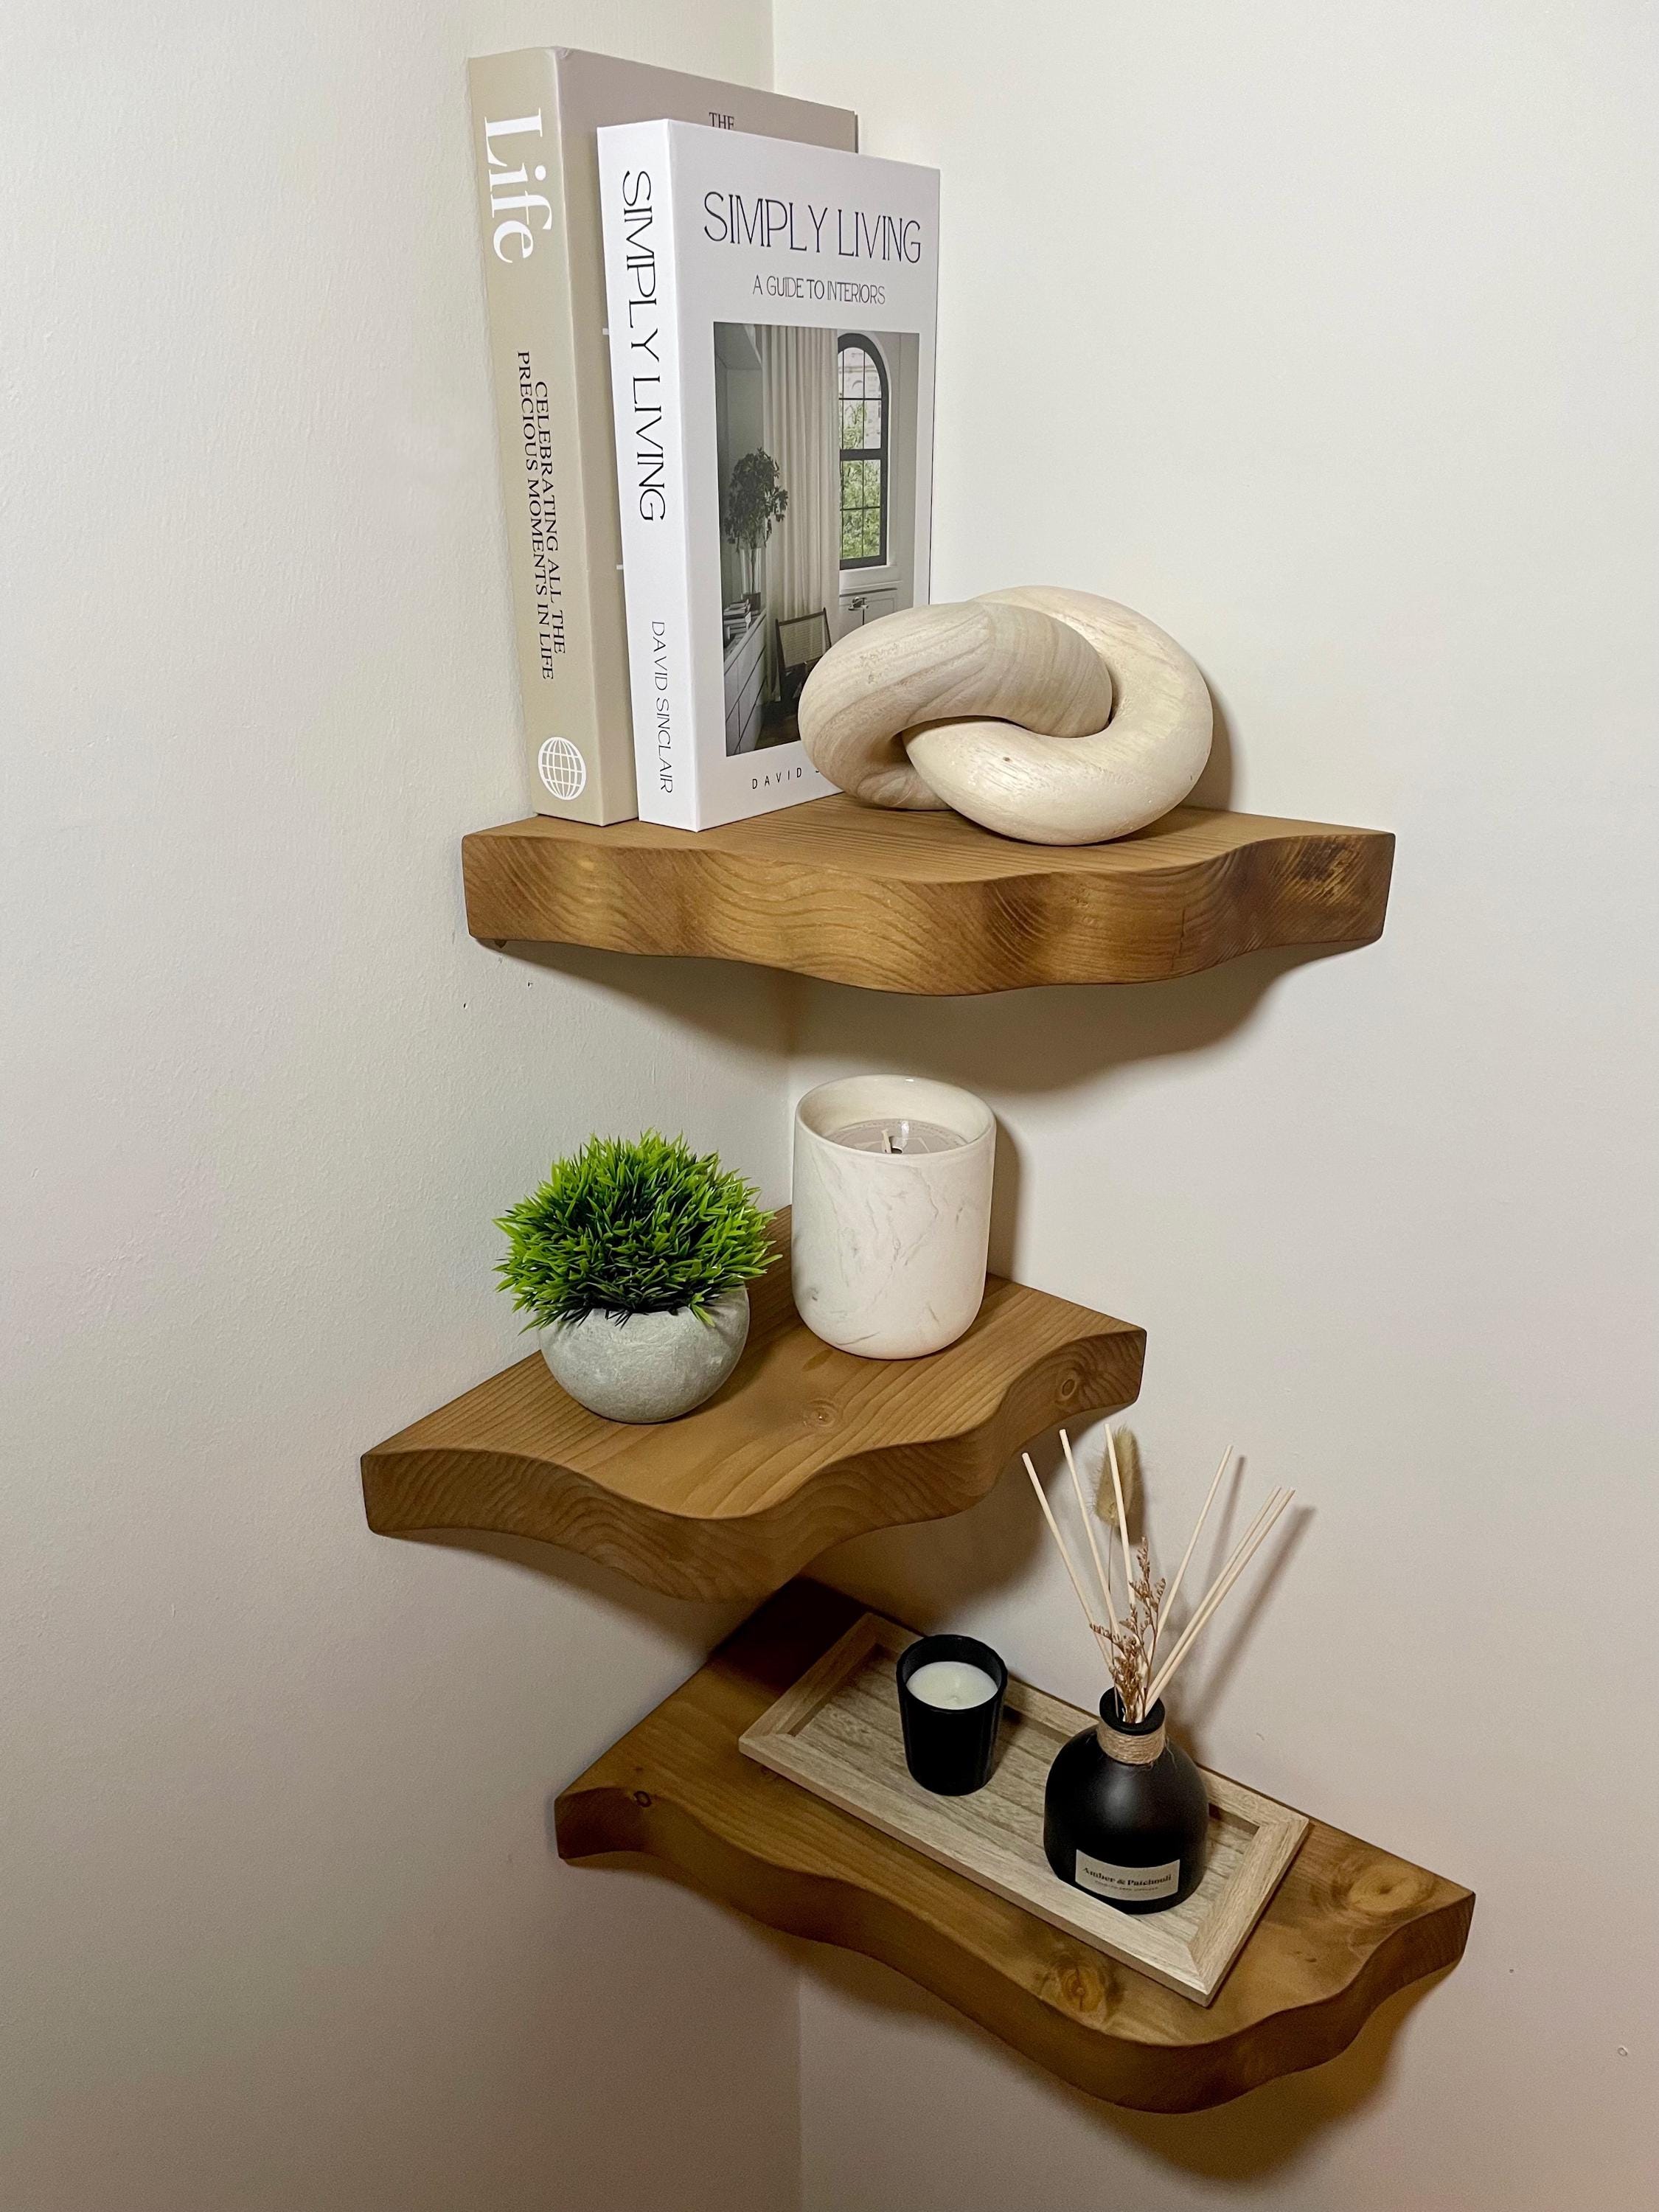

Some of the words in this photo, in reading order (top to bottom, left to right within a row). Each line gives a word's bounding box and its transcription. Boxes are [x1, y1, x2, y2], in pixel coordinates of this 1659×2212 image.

[709, 111, 735, 130] THE
[484, 107, 552, 264] Life
[703, 191, 828, 253] SIMPLY
[838, 209, 921, 263] LIVING
[622, 170, 660, 363] SIMPLY
[752, 274, 763, 295] A
[766, 276, 804, 299] GUIDE
[807, 279, 825, 300] TO
[827, 281, 886, 305] INTERIORS
[518, 351, 538, 471] PRECIOUS
[535, 380, 558, 552] CELEBRATING
[633, 375, 667, 522] LIVING
[527, 479, 547, 596] MOMENTS
[538, 603, 550, 626] IN
[548, 558, 562, 603] ALL
[539, 631, 554, 680] LIFE
[552, 610, 566, 654] THE
[651, 621, 668, 691] DAVID
[655, 697, 673, 793] SINCLAIR
[751, 767, 803, 790] DAVID
[1082, 1867, 1116, 1882] Amber
[1127, 1874, 1172, 1887] Patchouli
